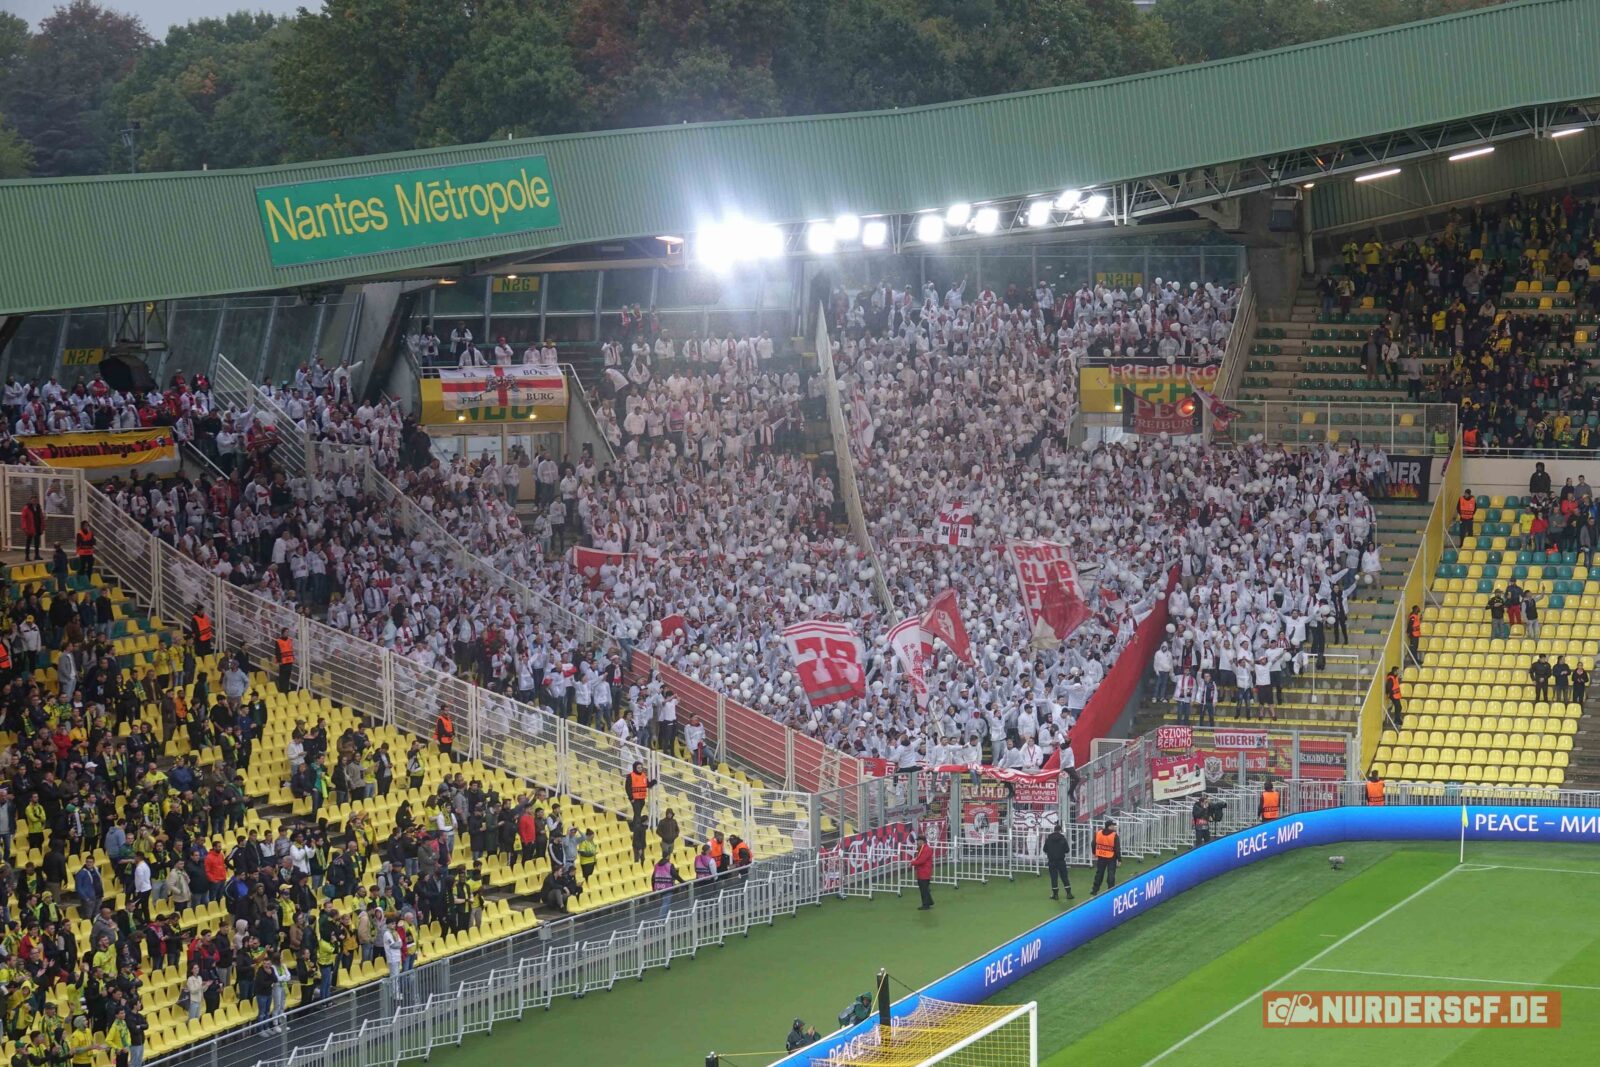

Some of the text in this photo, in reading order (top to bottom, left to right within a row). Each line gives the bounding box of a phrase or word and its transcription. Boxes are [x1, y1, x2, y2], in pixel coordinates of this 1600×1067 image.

[264, 193, 389, 243] Nantes
[1110, 364, 1216, 381] FREIBURG
[526, 391, 555, 400] BURG
[1129, 417, 1200, 429] FREIBURG
[1013, 545, 1063, 561] SPORT
[1020, 561, 1072, 583] CLUB
[795, 637, 860, 685] 79
[1157, 737, 1192, 749] BERLINO
[1158, 727, 1192, 739] SEZIONE
[1475, 813, 1539, 832] PEACE
[1560, 815, 1600, 833] МИ
[1237, 831, 1268, 858] PEACE
[1113, 887, 1138, 916] PEACE
[985, 953, 1013, 987] PEACE
[829, 1033, 865, 1067] PEACE
